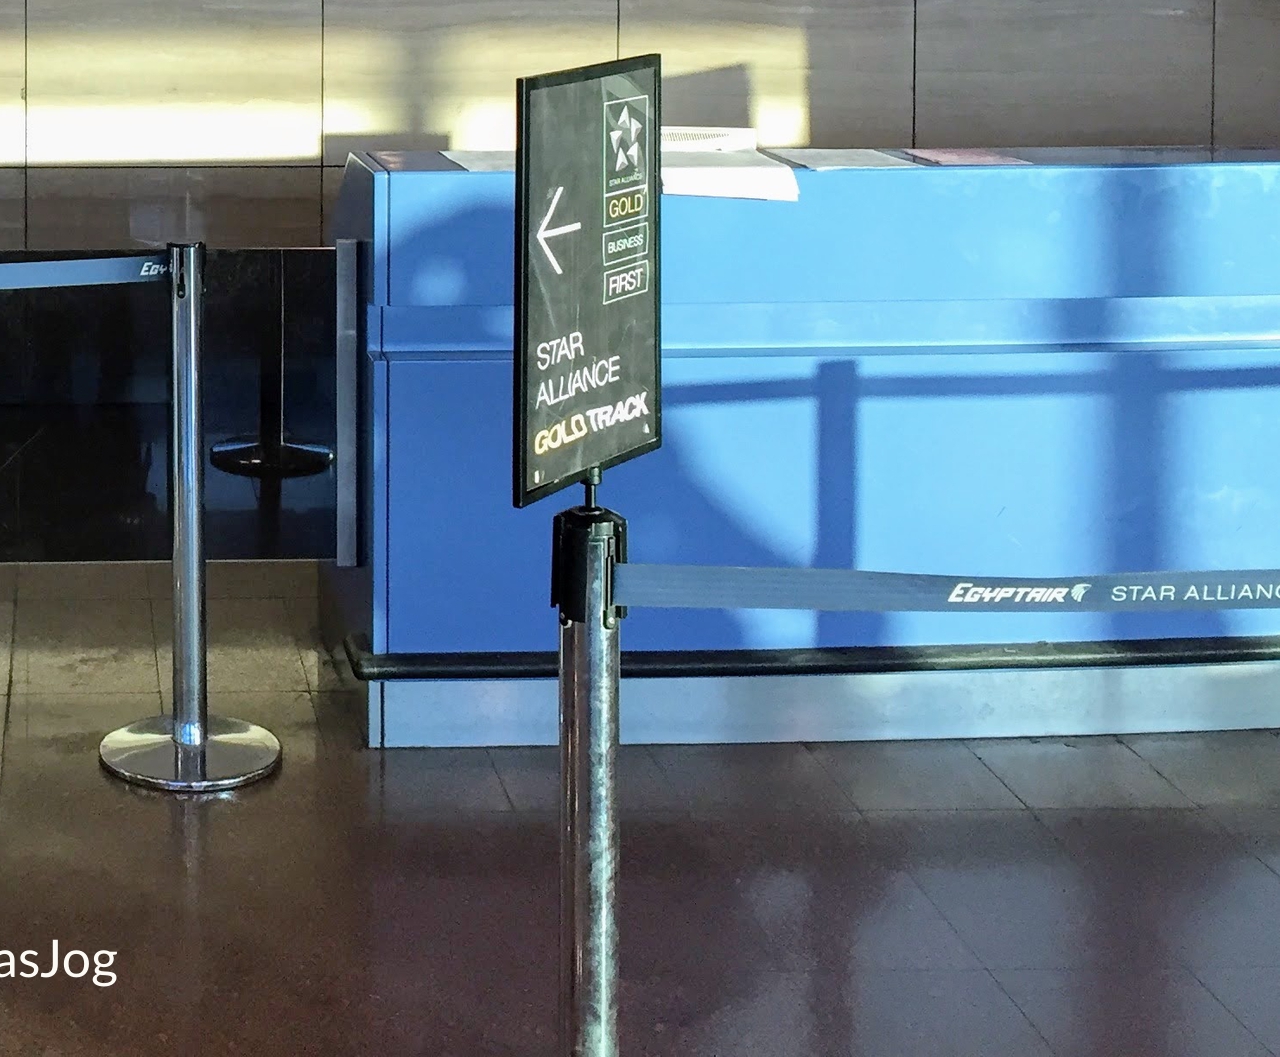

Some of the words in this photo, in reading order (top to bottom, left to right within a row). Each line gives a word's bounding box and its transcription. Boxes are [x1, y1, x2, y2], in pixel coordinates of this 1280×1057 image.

[608, 193, 644, 218] GOLD
[607, 233, 644, 254] BUSINESS
[608, 268, 644, 296] FIRST
[536, 331, 585, 371] STAR
[535, 355, 620, 411] ALLIANCE
[947, 582, 1070, 603] EGYPTAIR
[1111, 585, 1176, 602] STAR
